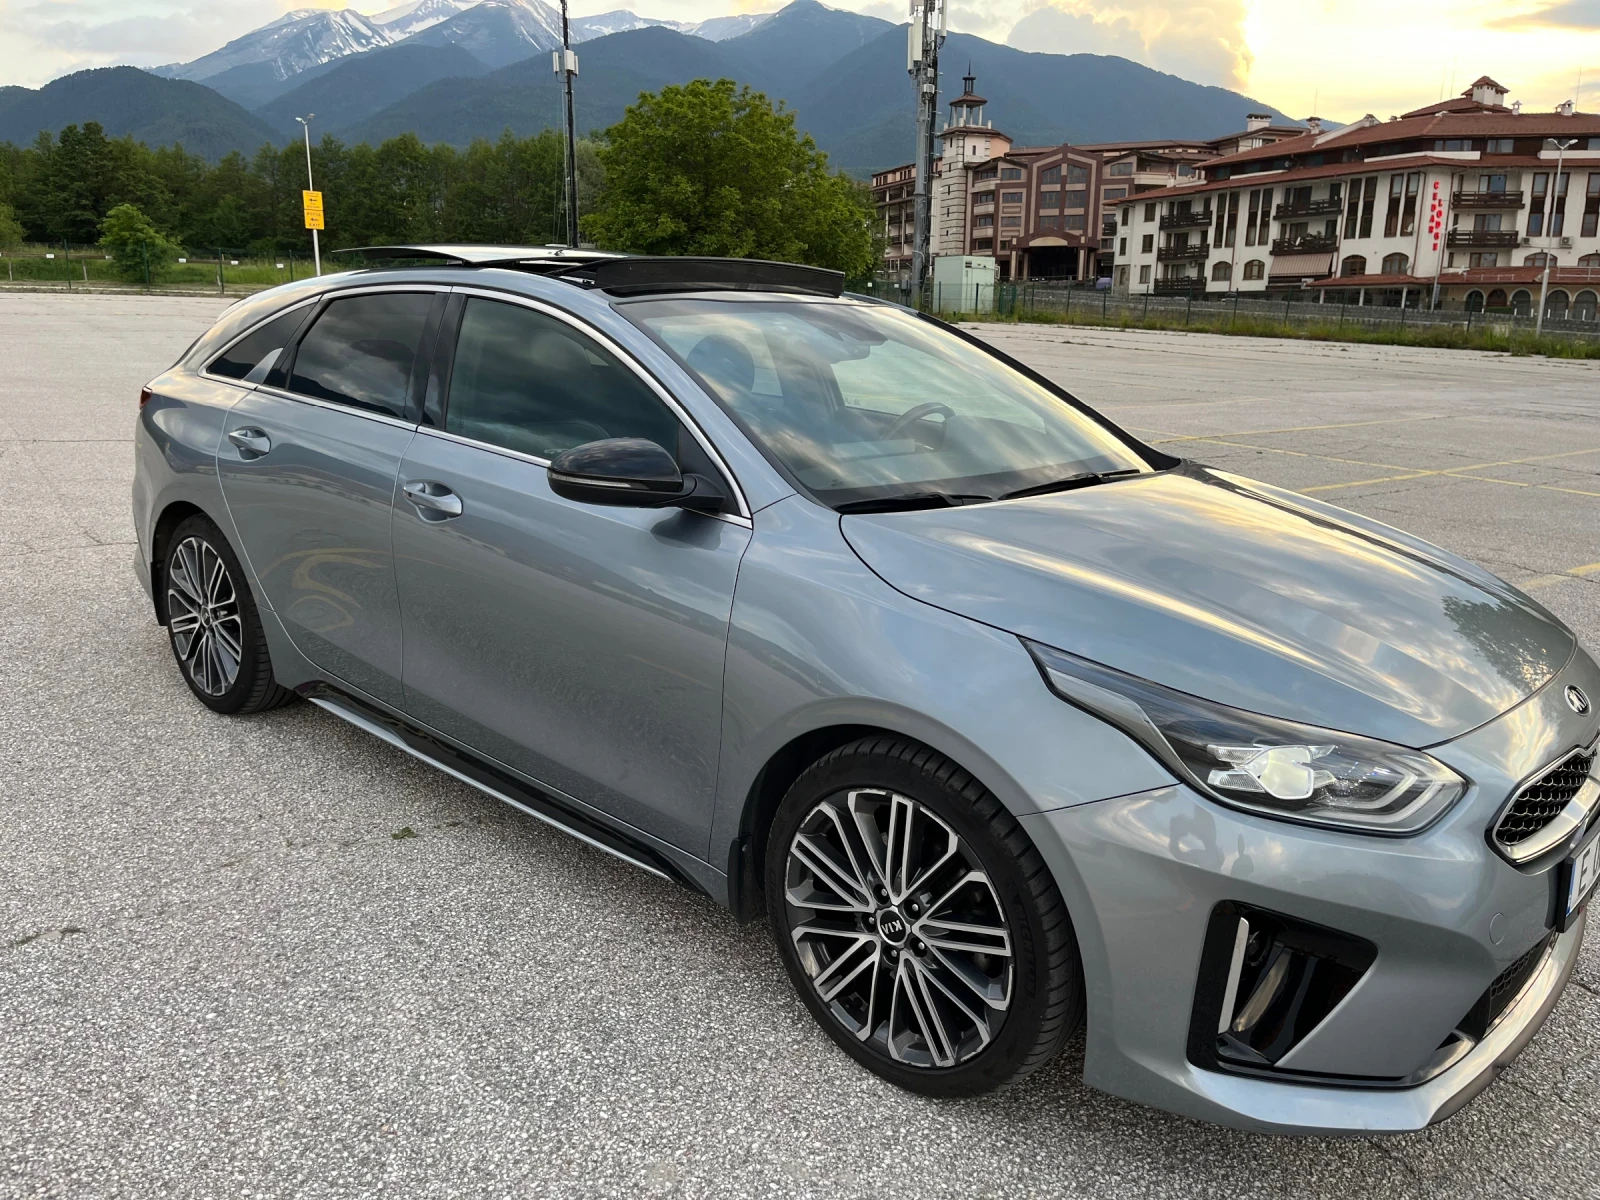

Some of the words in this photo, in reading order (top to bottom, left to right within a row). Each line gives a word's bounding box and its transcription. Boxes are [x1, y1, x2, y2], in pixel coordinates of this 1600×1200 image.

[1428, 181, 1440, 234] CEDAR
[1432, 199, 1443, 251] LODGE
[881, 920, 903, 934] KIA
